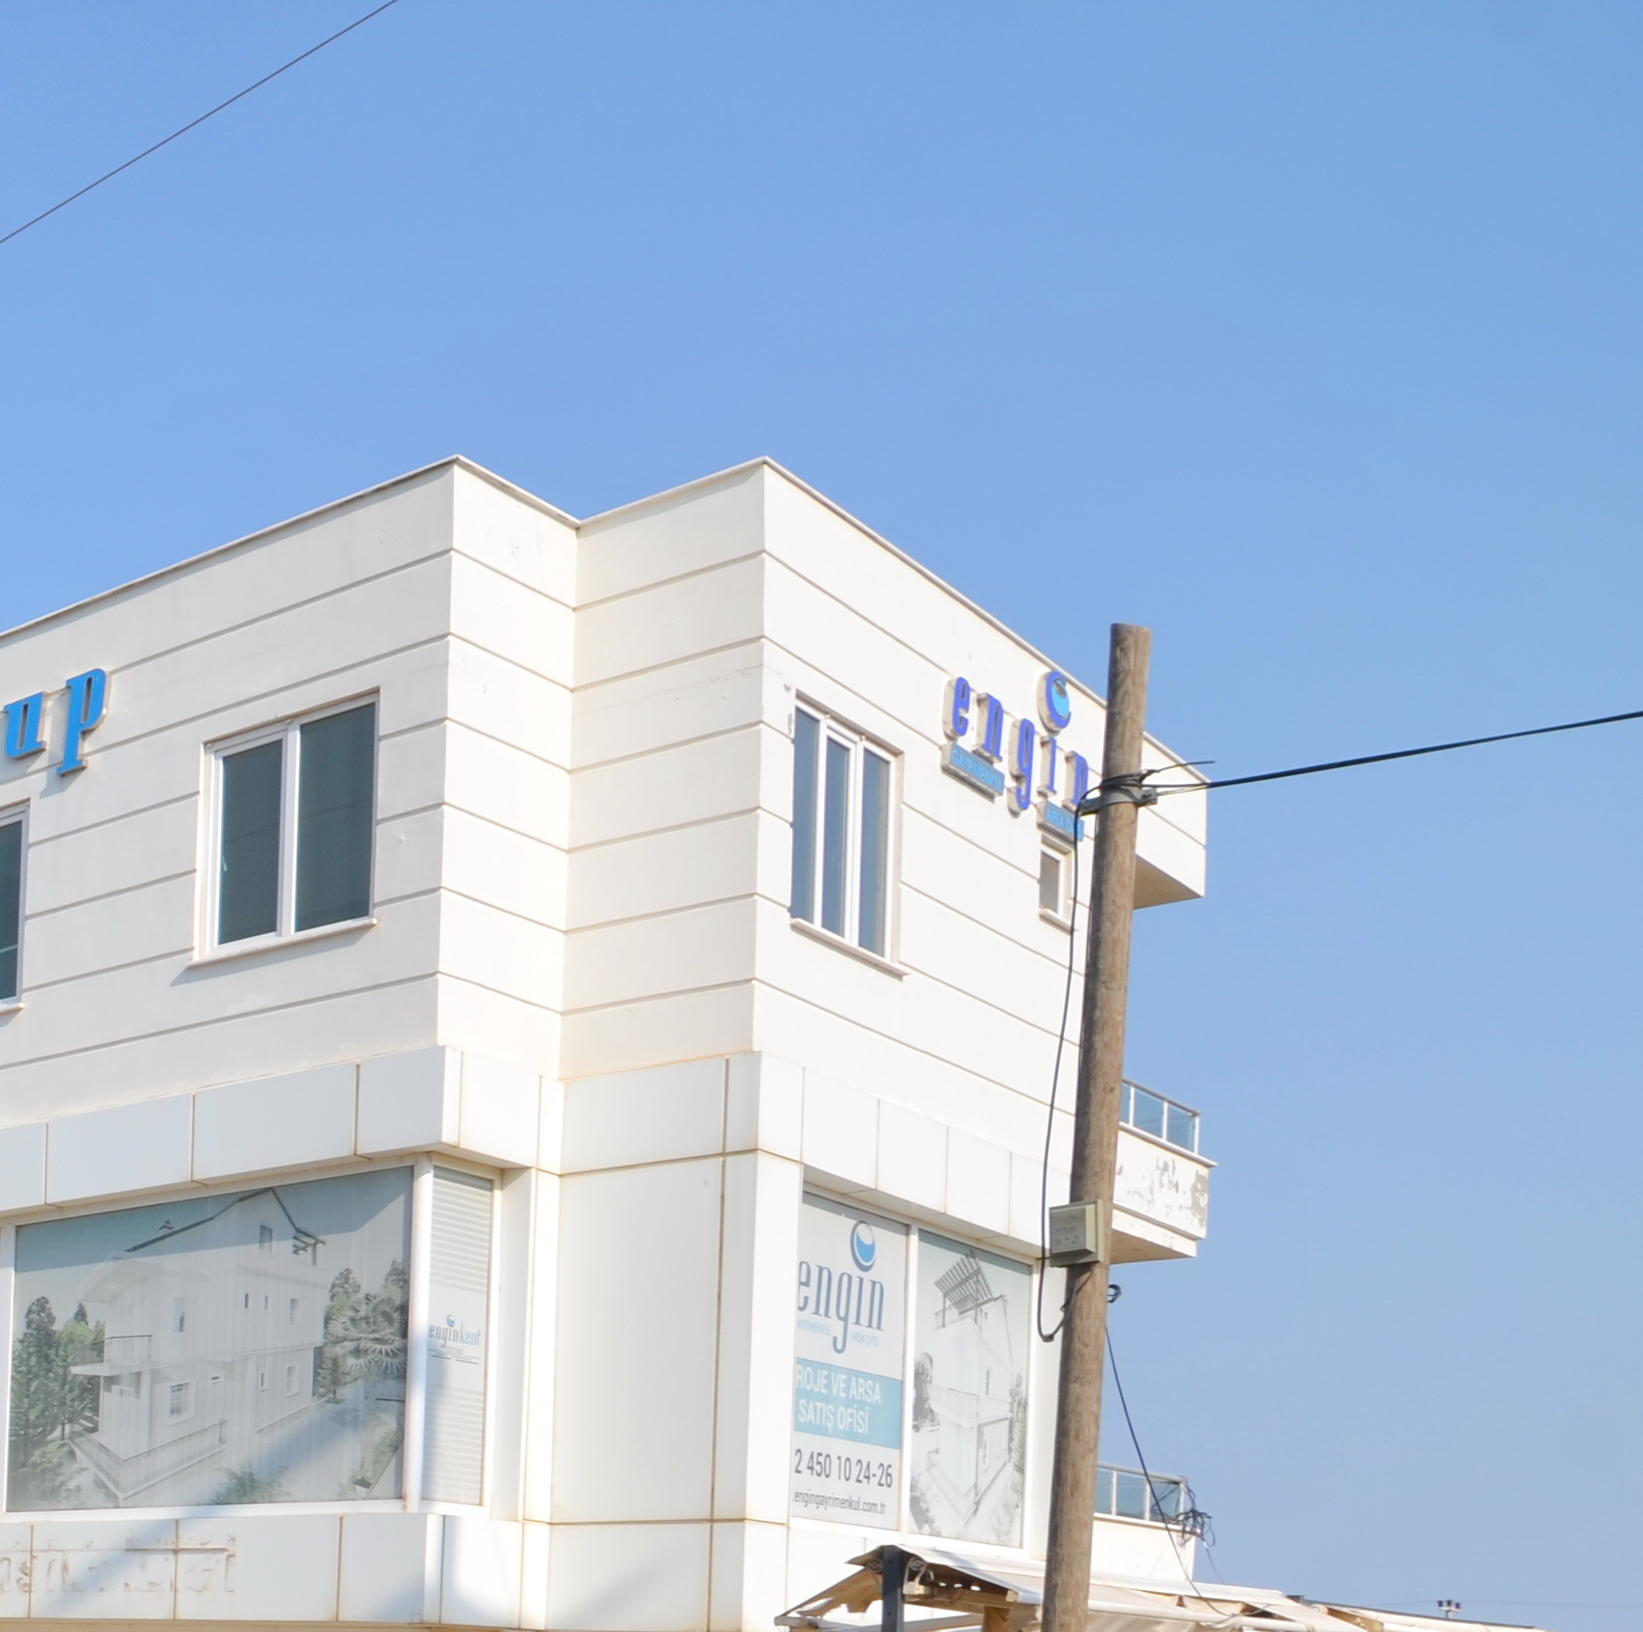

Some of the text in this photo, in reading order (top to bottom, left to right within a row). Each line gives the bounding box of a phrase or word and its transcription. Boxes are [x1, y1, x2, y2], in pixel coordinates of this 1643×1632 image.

[945, 671, 1090, 811] engin
[798, 1221, 885, 1354] engin
[831, 1371, 847, 1398] VE
[849, 1376, 881, 1405] ARSA
[798, 1398, 870, 1435] SATIŞ OFİSİ
[794, 1448, 803, 1474] 2
[806, 1451, 832, 1479] 450
[837, 1455, 852, 1482] 10
